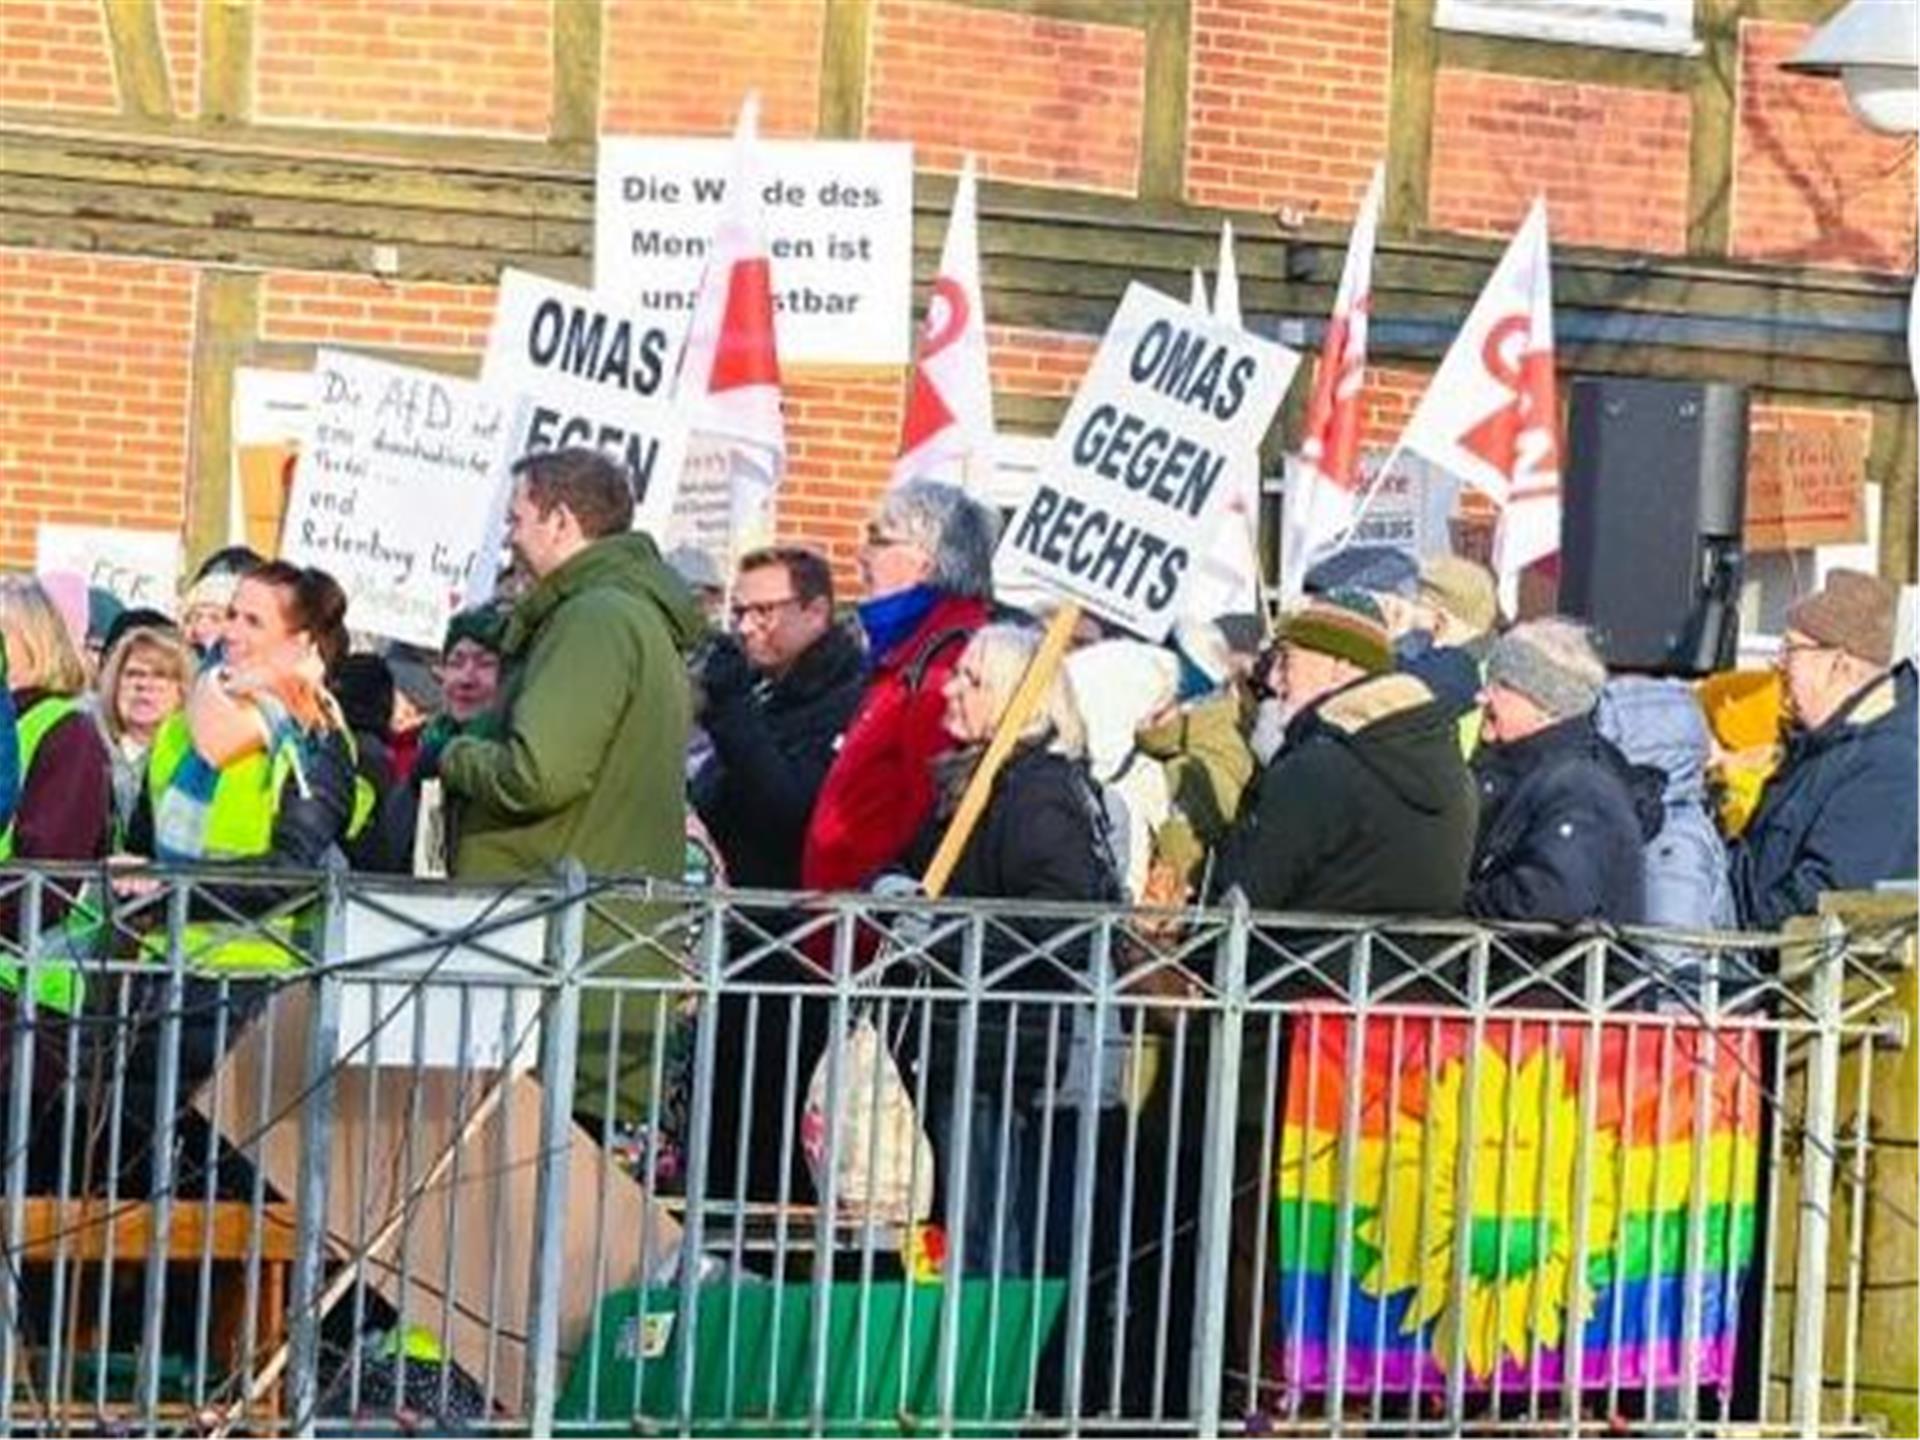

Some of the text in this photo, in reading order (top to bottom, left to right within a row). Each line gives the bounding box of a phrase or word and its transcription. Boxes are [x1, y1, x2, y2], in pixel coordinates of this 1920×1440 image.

[621, 176, 883, 208] Die Wde des
[631, 230, 873, 260] Menen ist
[528, 297, 668, 396] OMAS
[1129, 318, 1257, 422] OMAS
[375, 375, 452, 437] AfD
[1072, 404, 1227, 517] GEGEN
[309, 488, 358, 515] und
[1013, 486, 1190, 613] RECHTS
